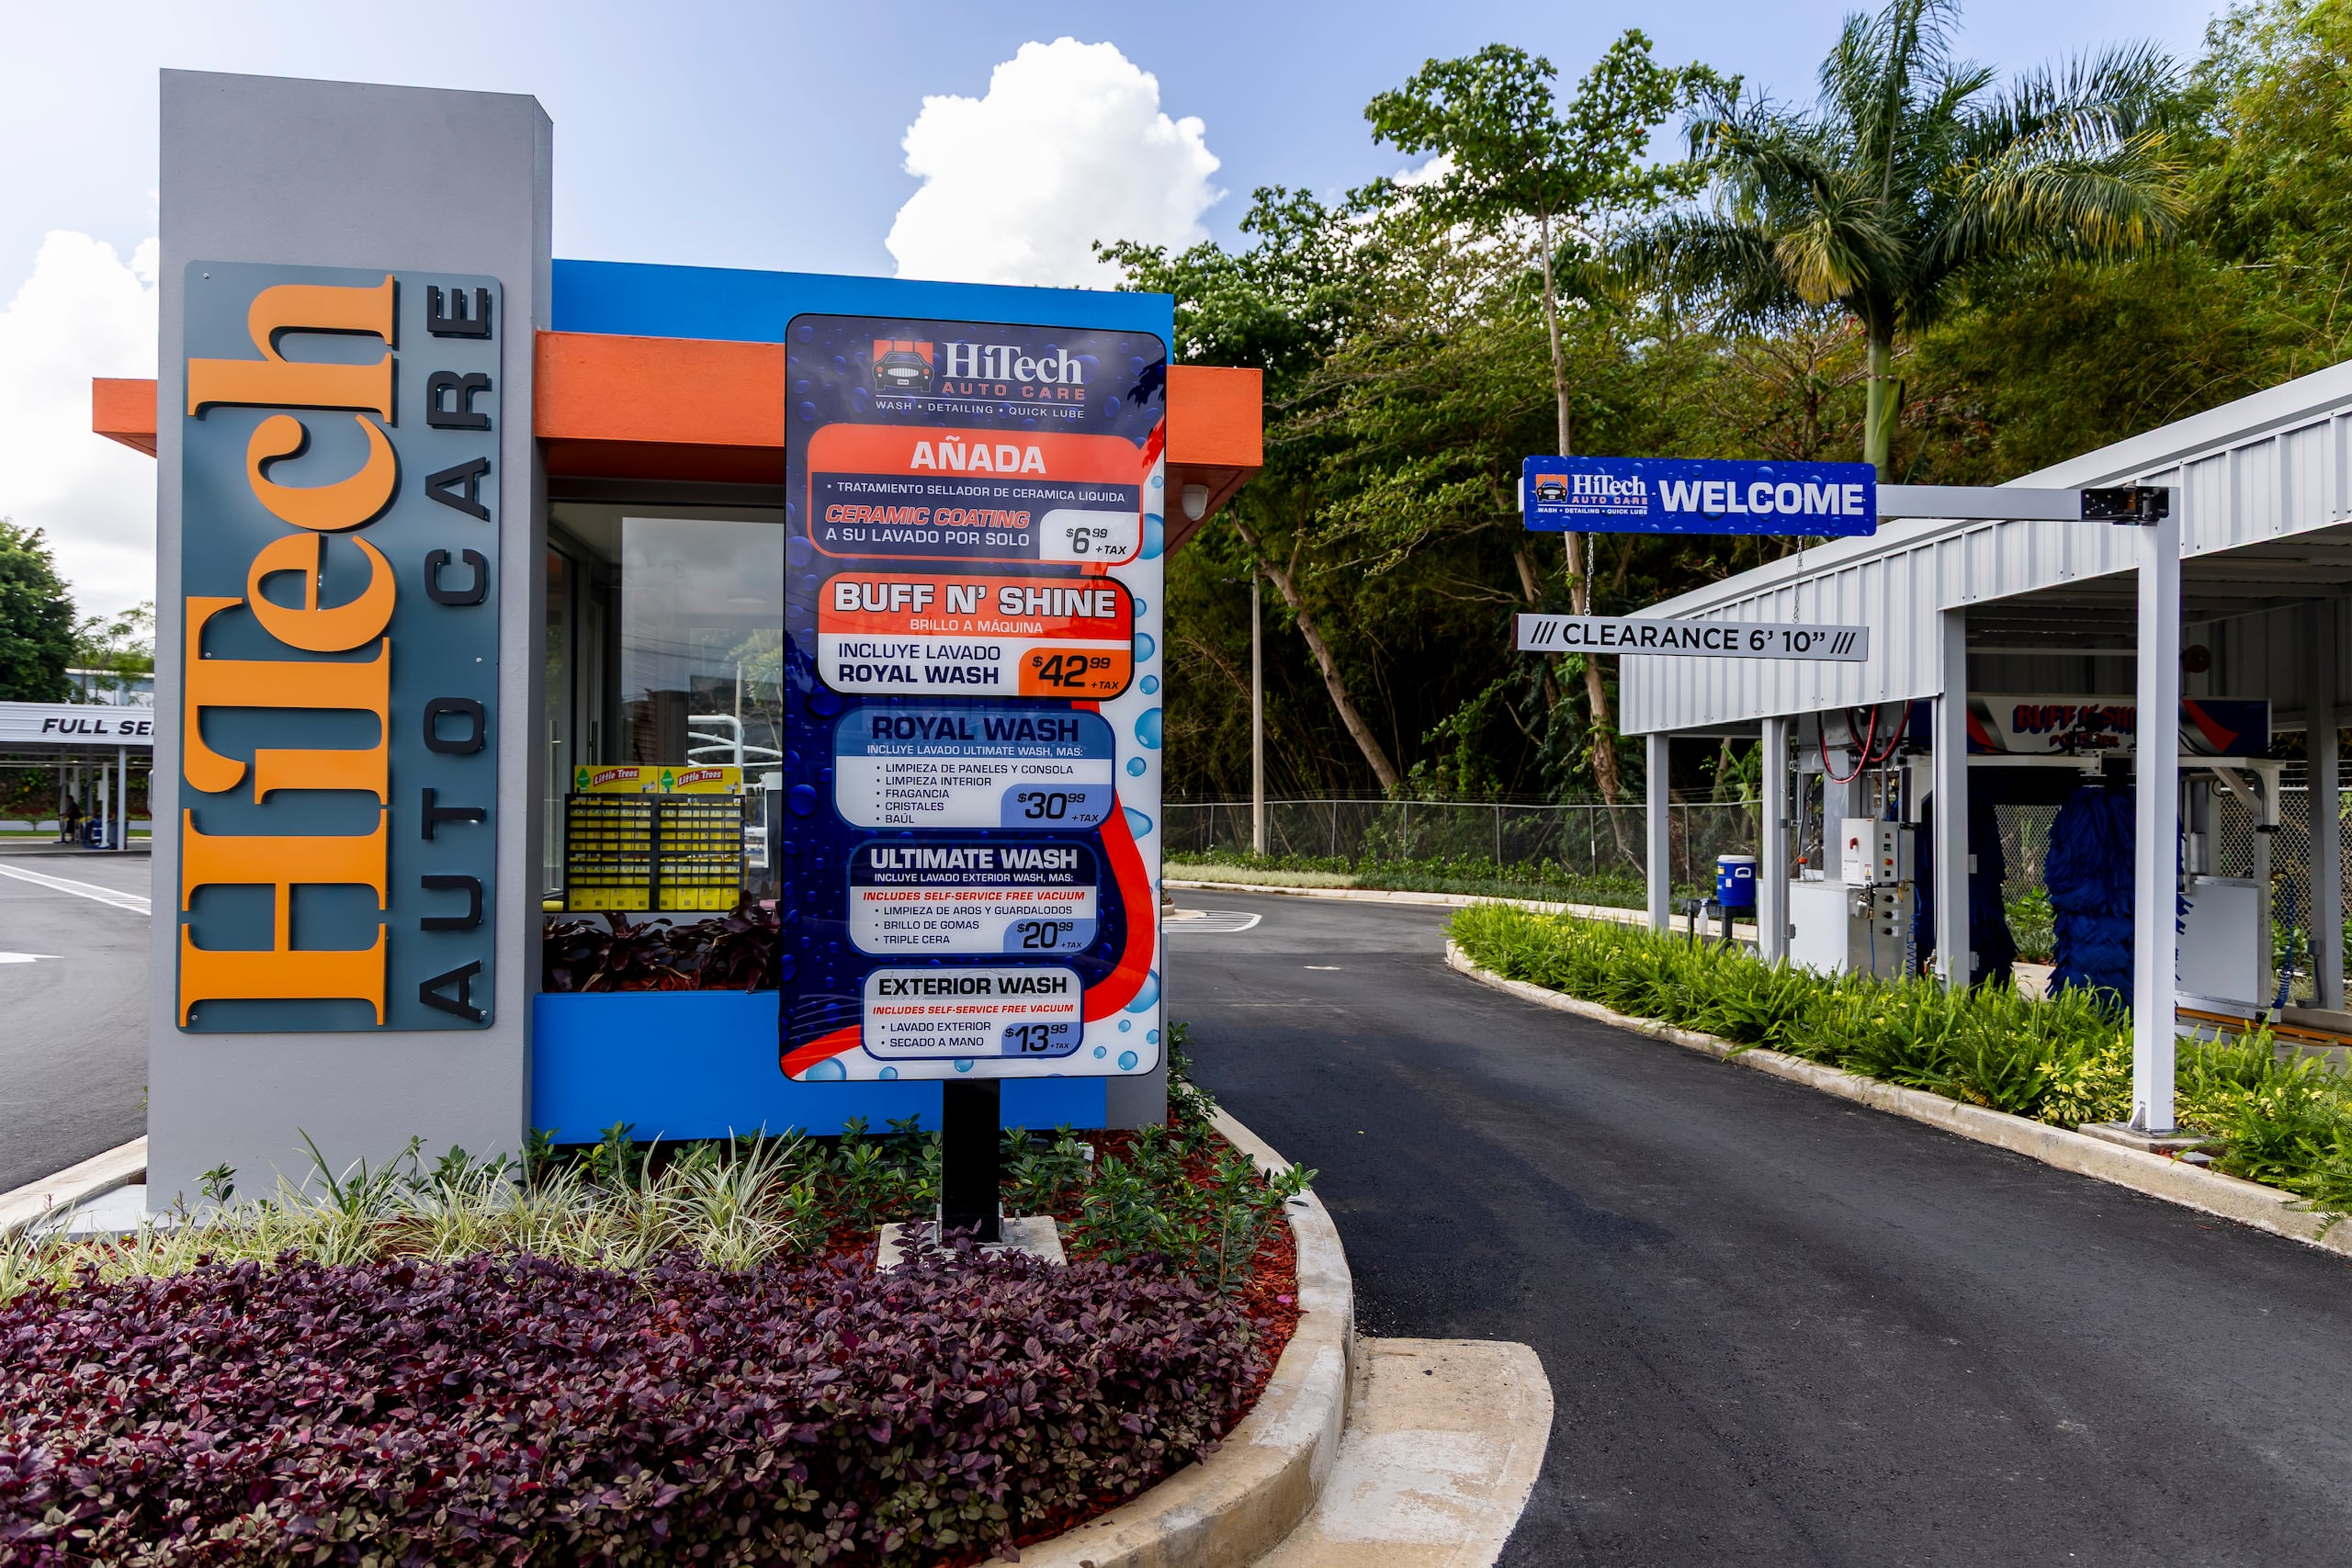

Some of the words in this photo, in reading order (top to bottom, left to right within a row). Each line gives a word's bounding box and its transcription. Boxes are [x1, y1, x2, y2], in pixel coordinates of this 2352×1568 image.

[942, 342, 1084, 385] HiTech
[942, 382, 1007, 397] AUTO
[1022, 386, 1085, 401] CARE
[876, 401, 912, 411] WASH
[928, 402, 993, 413] DETAILING
[1009, 406, 1047, 417] QUICK
[1053, 409, 1084, 419] LUBE
[424, 284, 491, 606] CARE
[910, 434, 1046, 475] AÑADA
[837, 481, 923, 494] TRATAMIENTO
[927, 485, 990, 497] SELLADOR
[994, 488, 1009, 498] DE
[1012, 489, 1075, 501] CERAMICA
[1079, 491, 1125, 502] LIQUIDA
[1571, 474, 1647, 496] HiTech
[1658, 479, 1864, 515] WELCOME
[1572, 496, 1607, 504] AUTO
[1613, 497, 1647, 505] CARE
[825, 504, 930, 525] CERAMIC
[933, 508, 1030, 529] COATING
[825, 527, 837, 540] A
[842, 528, 866, 542] SU
[872, 529, 939, 544] LAVADO
[945, 531, 980, 545] POR
[985, 532, 1029, 547] SOLO
[834, 581, 934, 614] BUFF
[946, 584, 987, 615] N'
[999, 586, 1117, 618] SHINE
[910, 618, 958, 632] BRILLO
[963, 619, 974, 632] A
[977, 618, 1043, 634] MÁQUINA
[1563, 622, 1739, 651] CLEARANCE
[180, 274, 398, 1027] HiTech
[838, 642, 920, 660] INCLUYE
[926, 645, 1001, 661] LAVADO
[838, 663, 918, 683] ROYAL
[925, 665, 999, 685] WASH
[41, 718, 108, 735] FULL
[118, 720, 154, 736] SE
[872, 715, 975, 741] ROYAL
[983, 716, 1079, 742] WASH
[2012, 705, 2077, 734] BUFF
[2100, 705, 2137, 735] SHI
[866, 744, 914, 754] INCLUYE
[917, 745, 960, 755] LAVADO
[964, 746, 1014, 756] ULTIMATE
[1018, 746, 1053, 758] WASH,
[1057, 746, 1083, 757] MAS:
[594, 770, 616, 785] Little
[616, 769, 639, 778] Trees
[678, 771, 700, 786] Little
[701, 770, 722, 779] Trees
[886, 763, 938, 773] LIMPIEZA
[941, 763, 956, 773] DE
[958, 764, 1008, 774] PANELES
[1011, 764, 1019, 774] Y
[1021, 765, 1074, 775] CONSOLA
[886, 776, 938, 786] LIMPIEZA
[941, 776, 992, 786] INTERIOR
[886, 789, 950, 799] FRAGANCIA
[885, 801, 944, 811] CRISTALES
[885, 812, 915, 824] BAÚL
[419, 697, 485, 1022] AUTO
[870, 848, 993, 869] ULTIMATE
[1000, 849, 1078, 870] WASH
[874, 873, 918, 883] INCLUYE
[920, 873, 960, 883] LAVADO
[963, 873, 1011, 883] EXTERIOR
[1012, 874, 1046, 884] WASH,
[1048, 874, 1073, 883] MAS:
[863, 891, 920, 901] INCLUDES
[923, 891, 1002, 901] SELF-SERVICE
[1005, 891, 1034, 900] FREE
[1037, 891, 1085, 900] VACUUM
[884, 906, 933, 916] LIMPIEZA
[936, 906, 951, 916] DE
[953, 906, 982, 915] AROS
[985, 906, 992, 915] Y
[994, 906, 1073, 915] GUARDALODOS
[884, 920, 921, 930] BRILLO
[923, 920, 938, 930] DE
[941, 920, 979, 930] GOMAS
[883, 935, 919, 944] TRIPLE
[922, 935, 950, 944] CERA
[878, 977, 991, 996] EXTERIOR
[998, 976, 1068, 994] WASH
[872, 1006, 925, 1015] INCLUDES
[927, 1005, 999, 1014] SELF-SERVICE
[1001, 1005, 1028, 1013] FREE
[1030, 1004, 1074, 1013] VACUUM
[890, 1022, 934, 1032] LAVADO
[937, 1021, 991, 1032] EXTERIOR
[889, 1038, 935, 1047] SECADO
[938, 1038, 947, 1046] A
[949, 1037, 984, 1046] MANO
